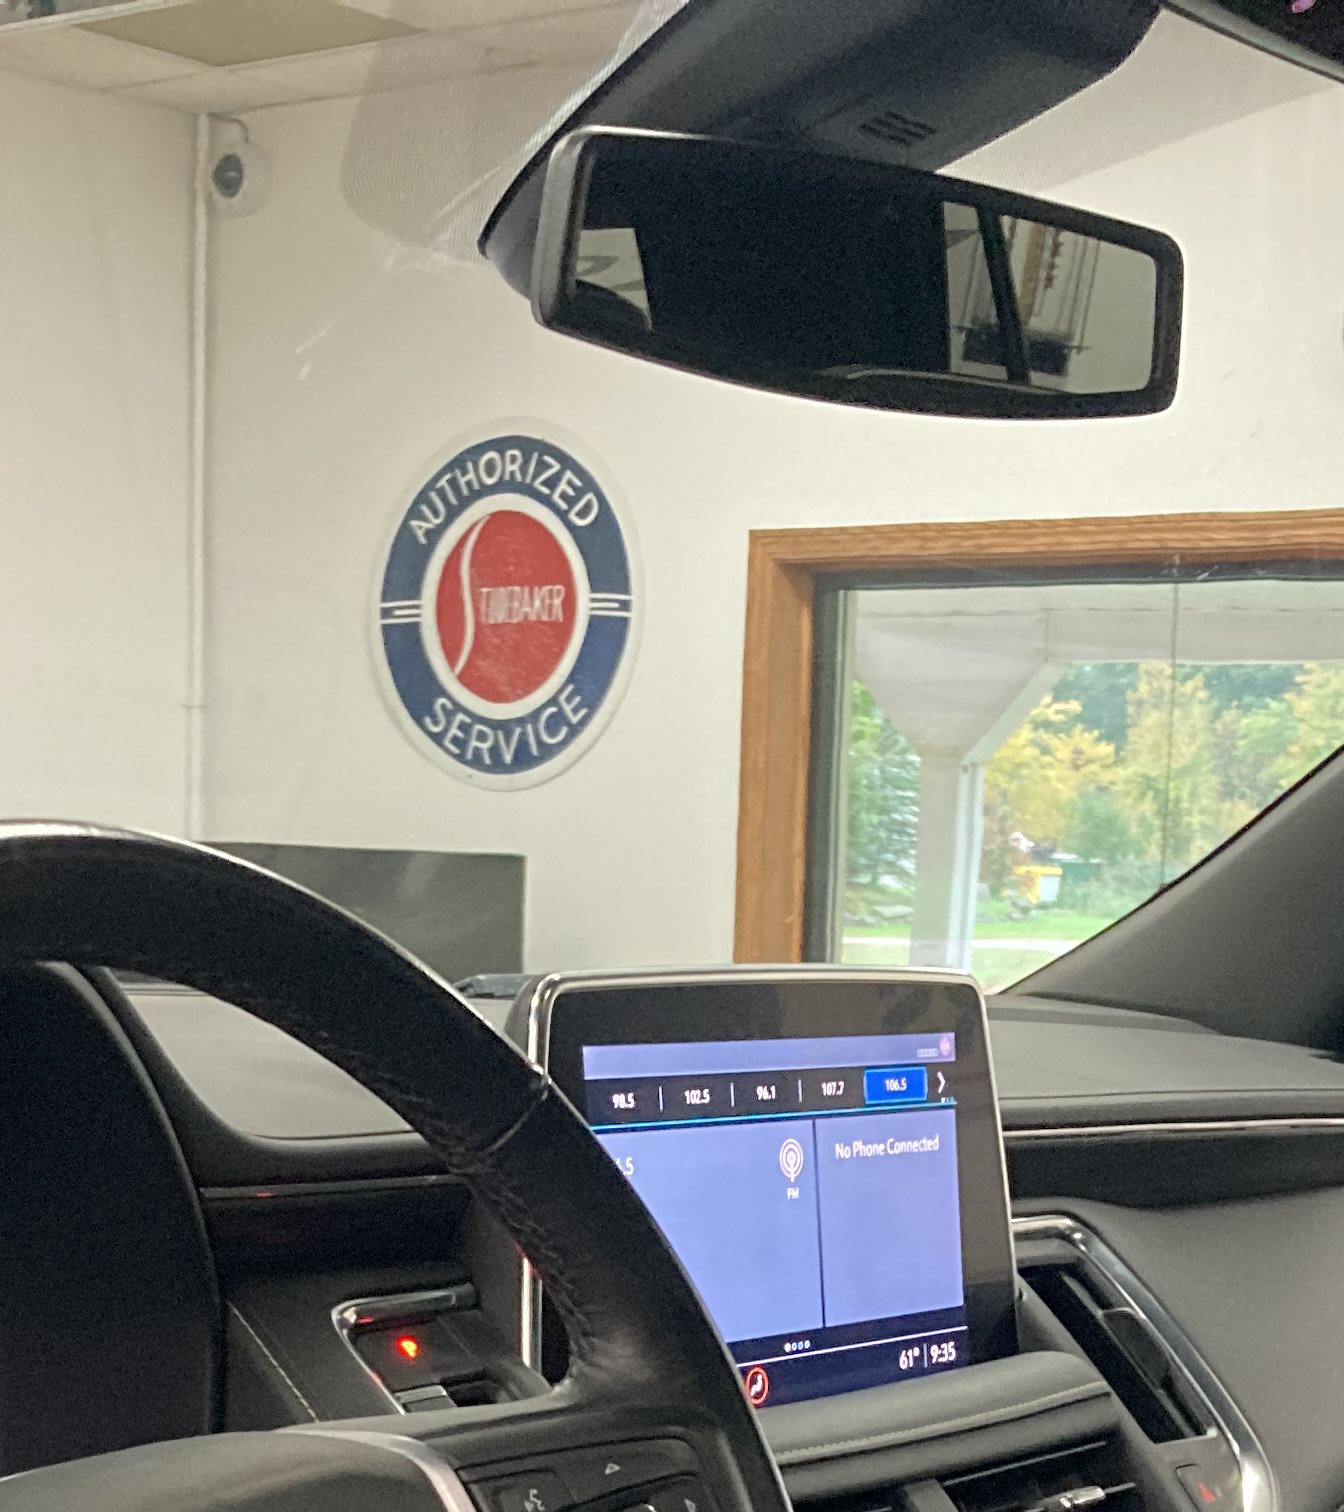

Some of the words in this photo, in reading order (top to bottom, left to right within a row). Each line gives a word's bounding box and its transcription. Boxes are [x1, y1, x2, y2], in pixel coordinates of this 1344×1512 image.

[407, 448, 600, 545] AUTHORIZED
[423, 684, 590, 766] SERVICE
[835, 1142, 852, 1160] No
[852, 1139, 885, 1158] Phone
[886, 1133, 940, 1155] Connected
[786, 1187, 799, 1200] FM
[930, 1341, 957, 1365] 9:35
